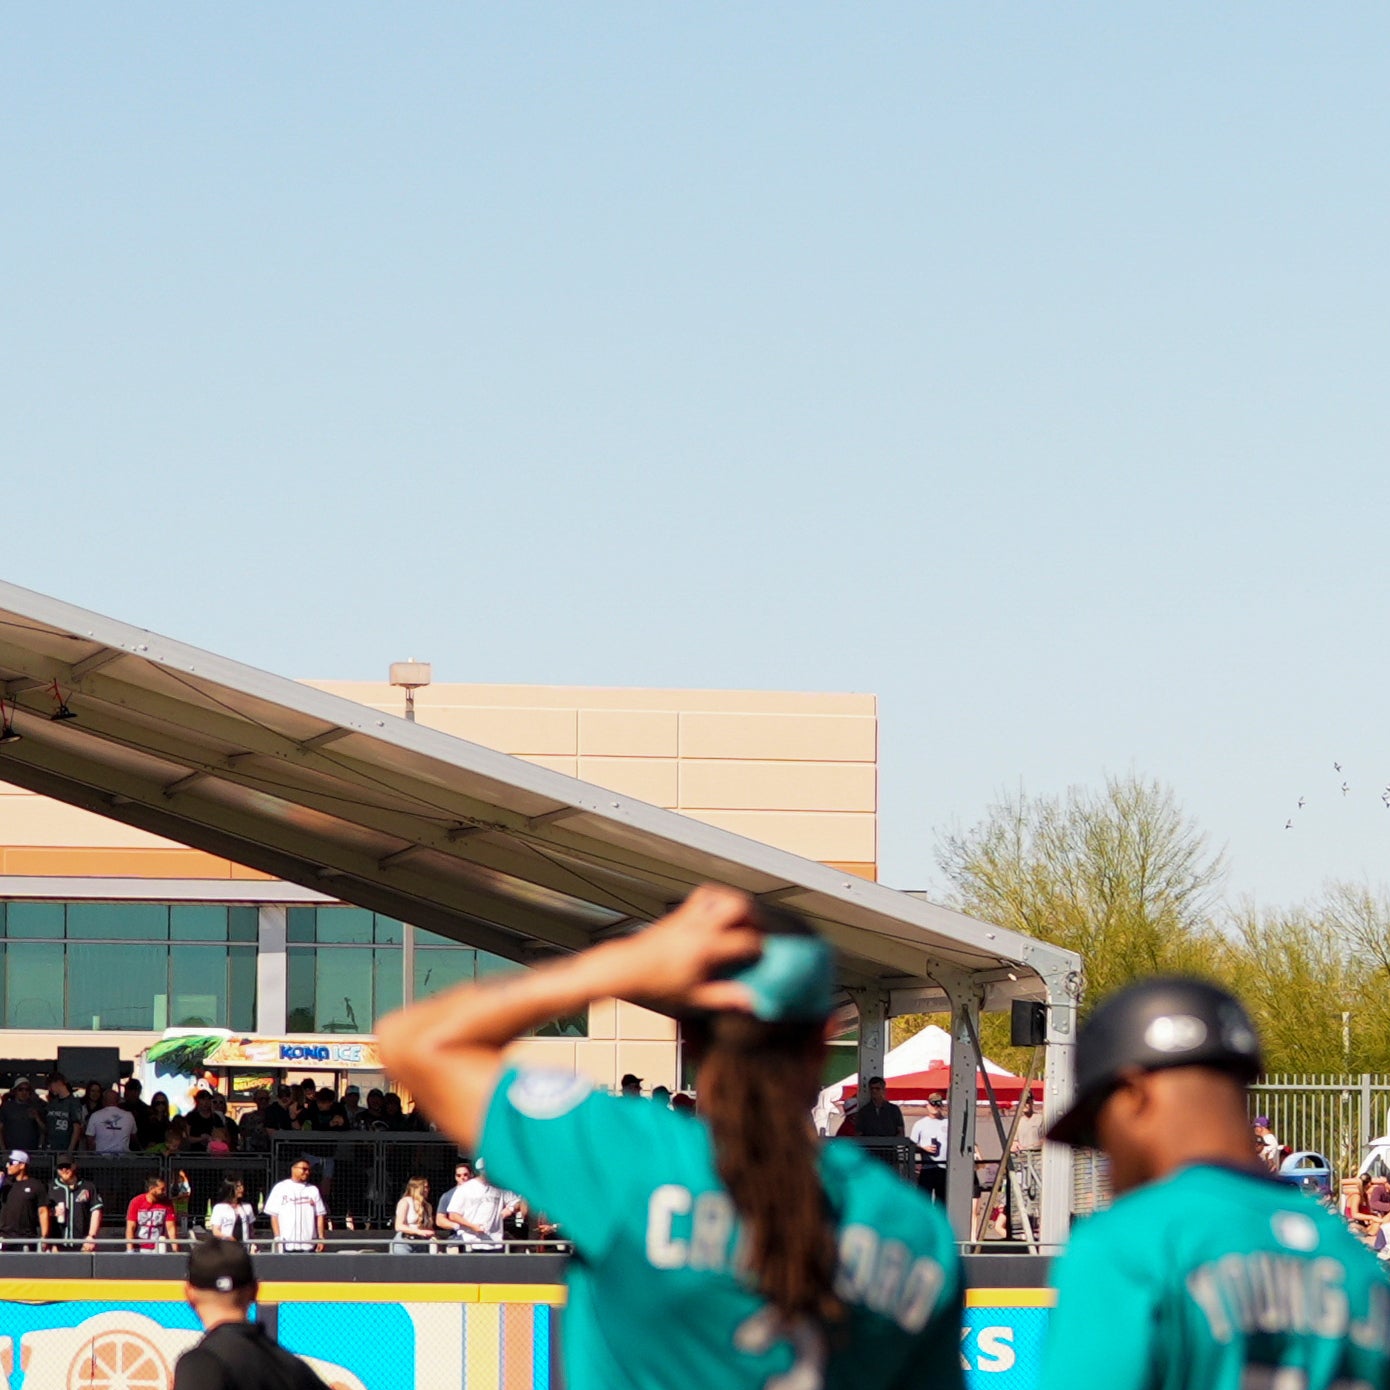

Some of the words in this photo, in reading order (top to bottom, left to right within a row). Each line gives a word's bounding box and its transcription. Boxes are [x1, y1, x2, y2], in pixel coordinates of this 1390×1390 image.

[281, 1044, 331, 1061] KONA
[332, 1045, 361, 1062] ICE
[1186, 1252, 1348, 1345] YOUNG
